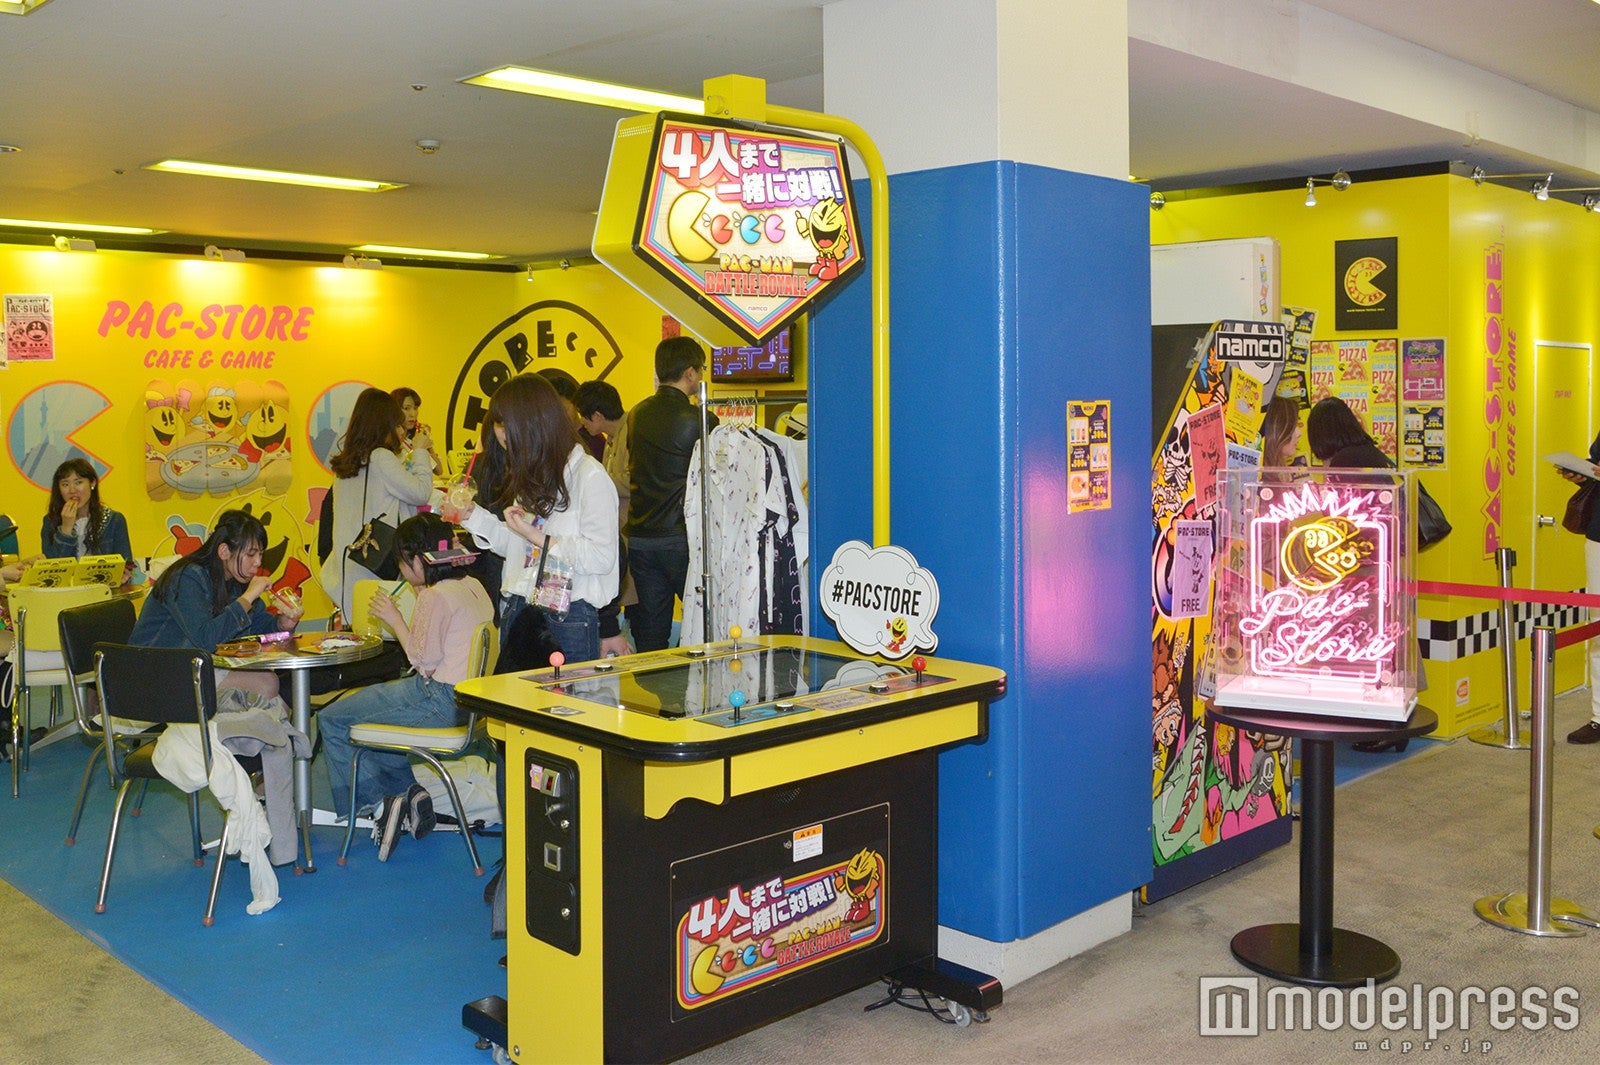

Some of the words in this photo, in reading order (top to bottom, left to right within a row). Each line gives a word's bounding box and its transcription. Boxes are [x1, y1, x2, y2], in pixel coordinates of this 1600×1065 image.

[661, 131, 779, 179] 4人まで
[719, 253, 794, 274] PAC-MAN
[705, 271, 758, 296] BATTLE
[759, 274, 808, 297] ROYALE
[98, 300, 315, 342] PAC-STORE
[144, 349, 194, 369] CAFE
[198, 350, 214, 369] &
[220, 350, 276, 369] GAME
[1218, 337, 1282, 358] namco
[1338, 348, 1368, 361] PIZZA
[1507, 327, 1516, 392] GAME
[1312, 371, 1334, 385] IZZA
[1371, 370, 1396, 384] PIZZ
[1344, 399, 1368, 412] ZZA
[1484, 246, 1504, 557] PAC-STORE
[1189, 409, 1221, 430] PAC-STORE
[1371, 422, 1396, 435] PIZZ
[1228, 449, 1258, 466] PAC-STORE
[1507, 422, 1516, 476] CAFE
[1177, 526, 1210, 537] PAC-STORE
[832, 579, 921, 617] #PACSTORE
[1181, 598, 1201, 612] FREE
[1239, 588, 1369, 635] Pac-
[1260, 620, 1396, 666] Store
[687, 877, 783, 939] 4人まで
[788, 916, 841, 944] PAC-MAN
[777, 935, 816, 967] BATTLE
[815, 926, 851, 955] ROYALE
